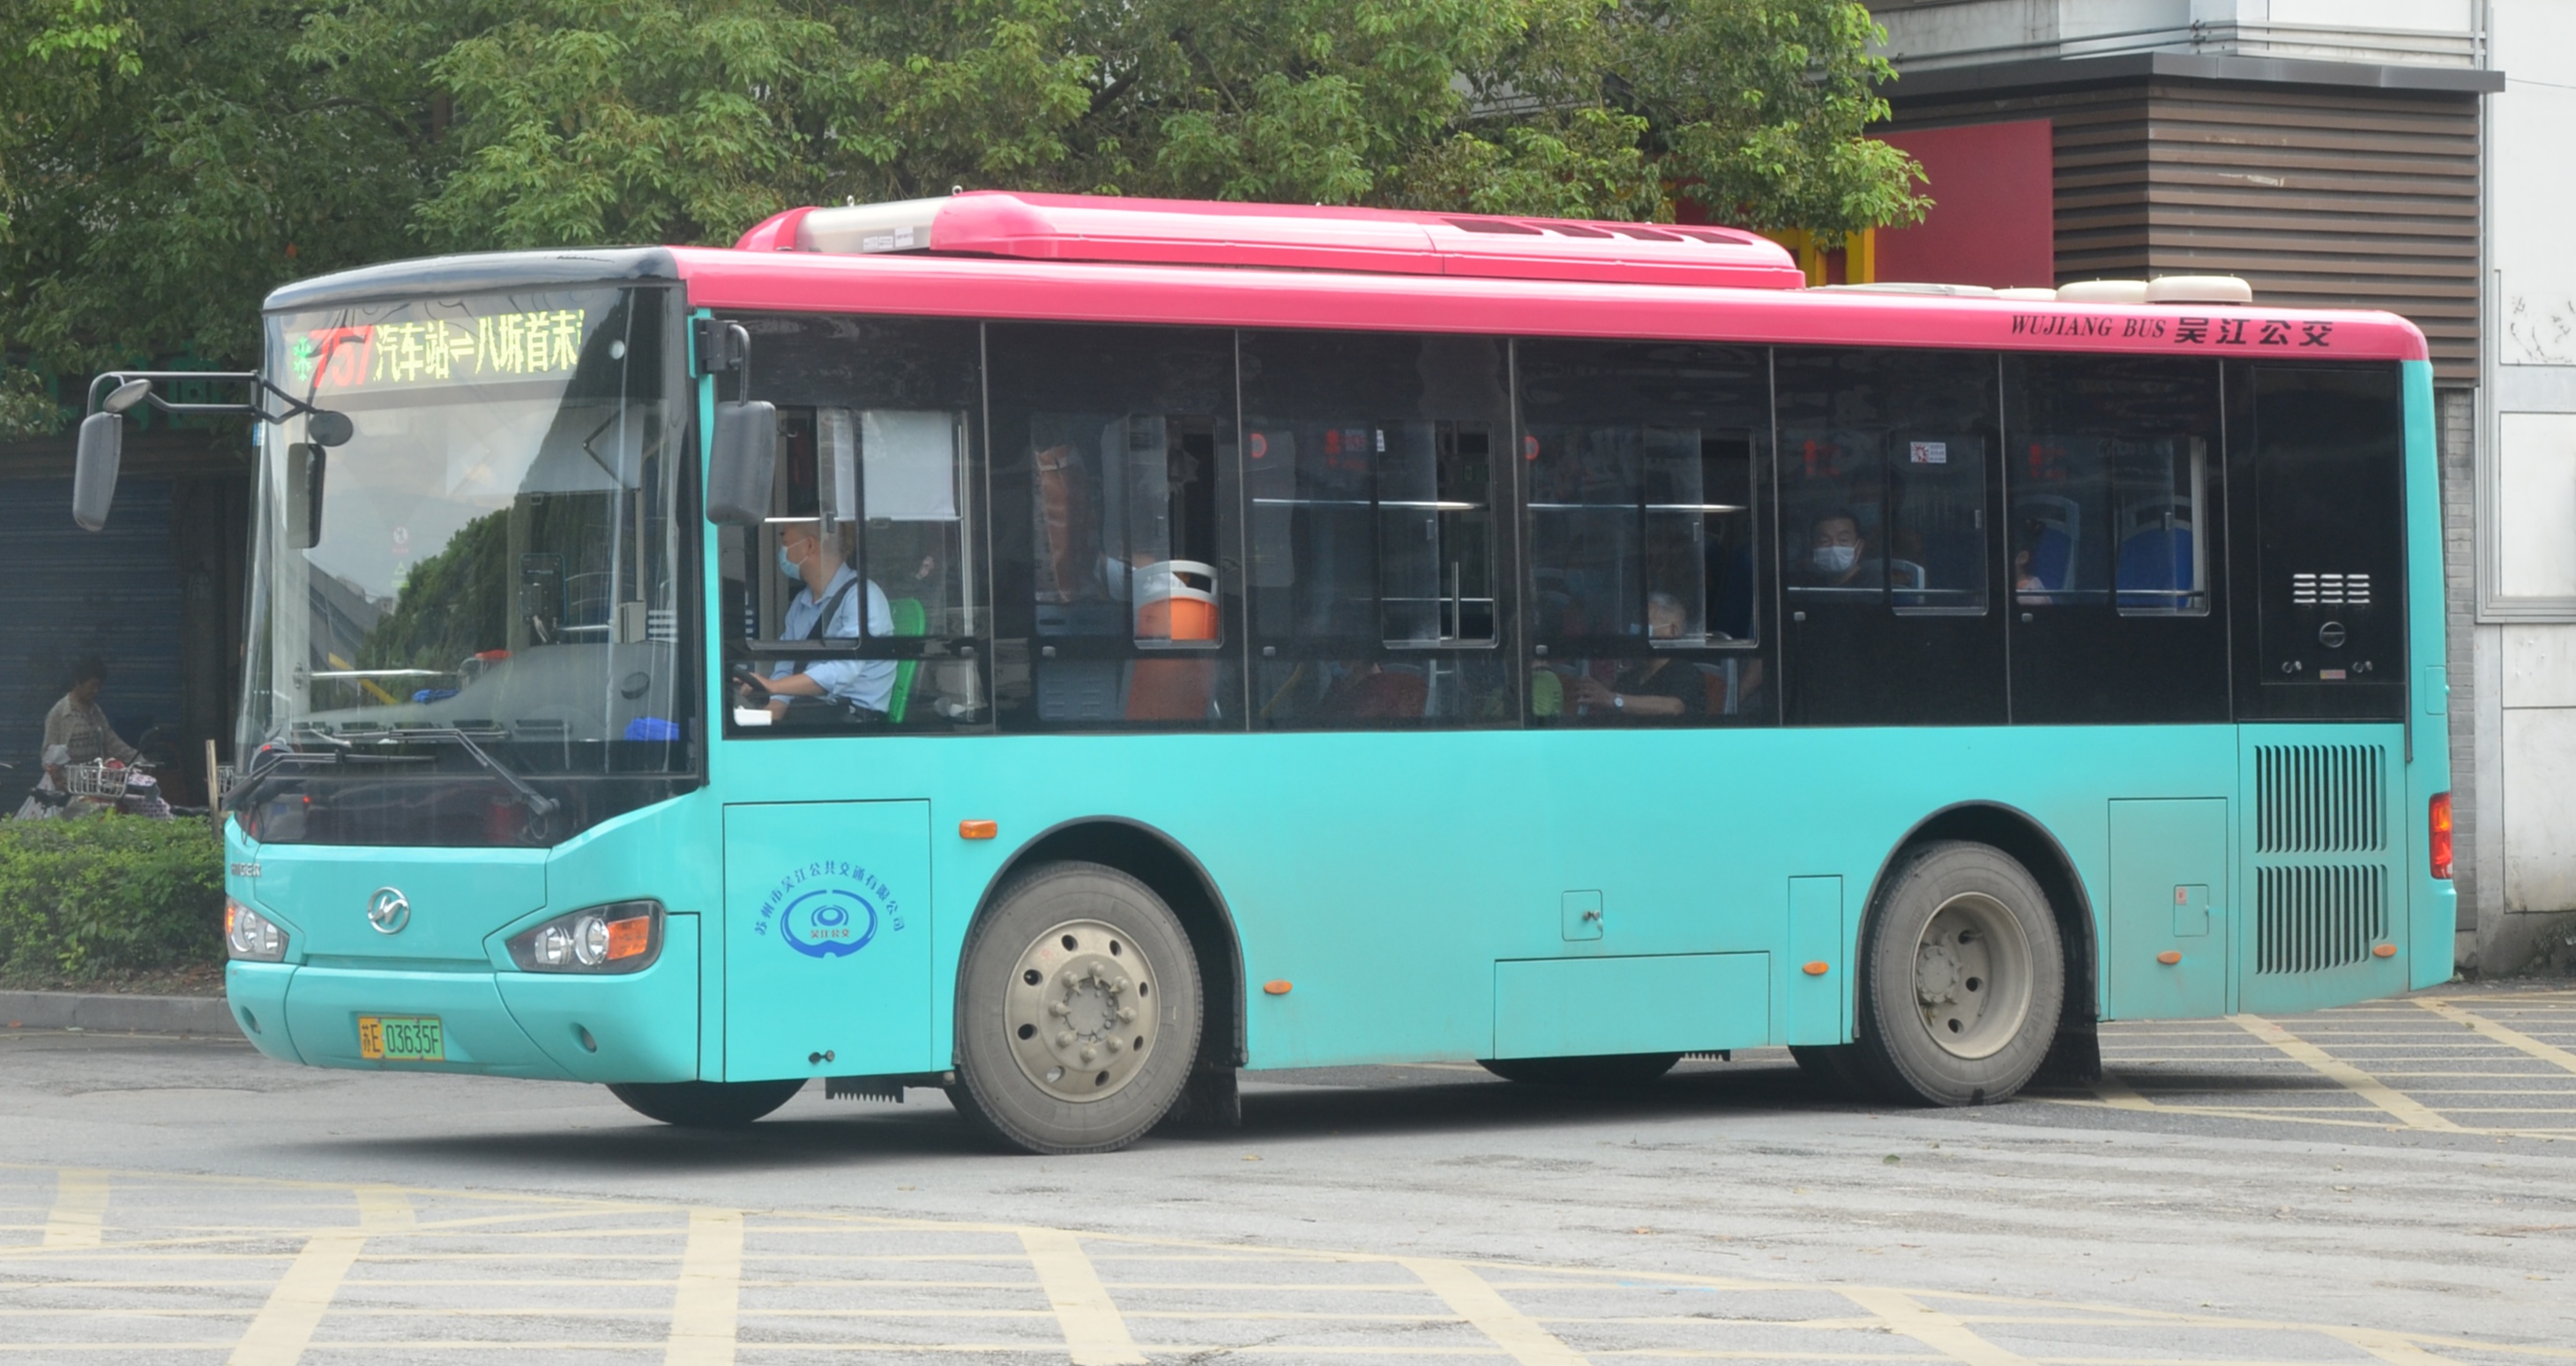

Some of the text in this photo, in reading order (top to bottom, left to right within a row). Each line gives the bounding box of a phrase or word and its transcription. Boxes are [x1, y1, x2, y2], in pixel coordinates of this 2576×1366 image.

[2011, 315, 2333, 347] WUJIANG BUS 吴江公交
[310, 325, 374, 388] 757
[754, 860, 905, 937] 苏州市吴江公共交通有限公司
[810, 929, 850, 939] 吴江公交
